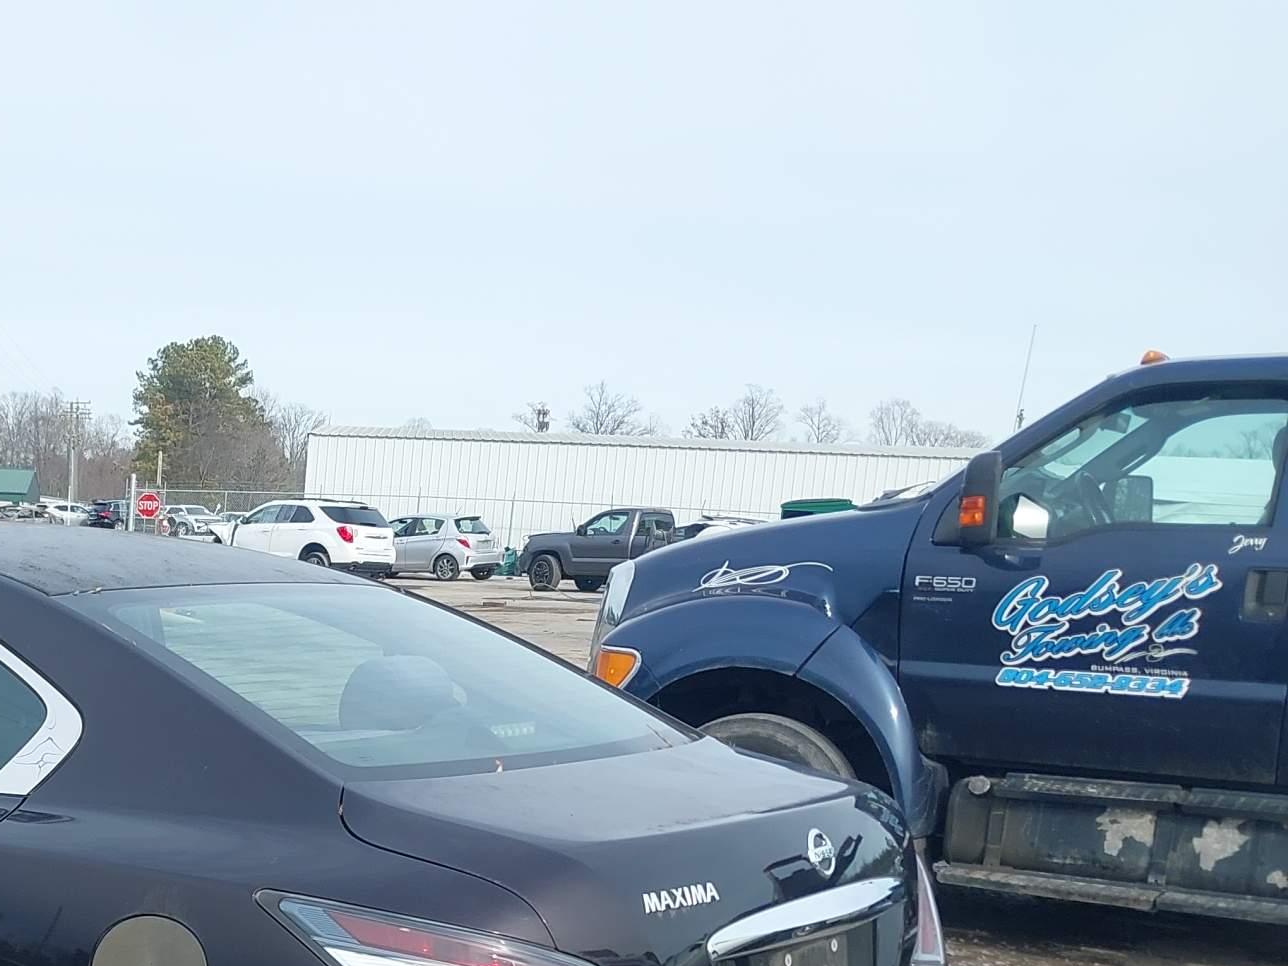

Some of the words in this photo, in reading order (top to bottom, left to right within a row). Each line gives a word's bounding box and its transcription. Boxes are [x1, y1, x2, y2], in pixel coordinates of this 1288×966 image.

[138, 500, 159, 511] STOP
[992, 563, 1223, 634] Godsey's
[1000, 621, 1151, 665] Towing
[1090, 664, 1142, 675] BUMPASS,
[1144, 668, 1189, 677] VIRGINIA
[642, 882, 720, 914] MAXIMA
